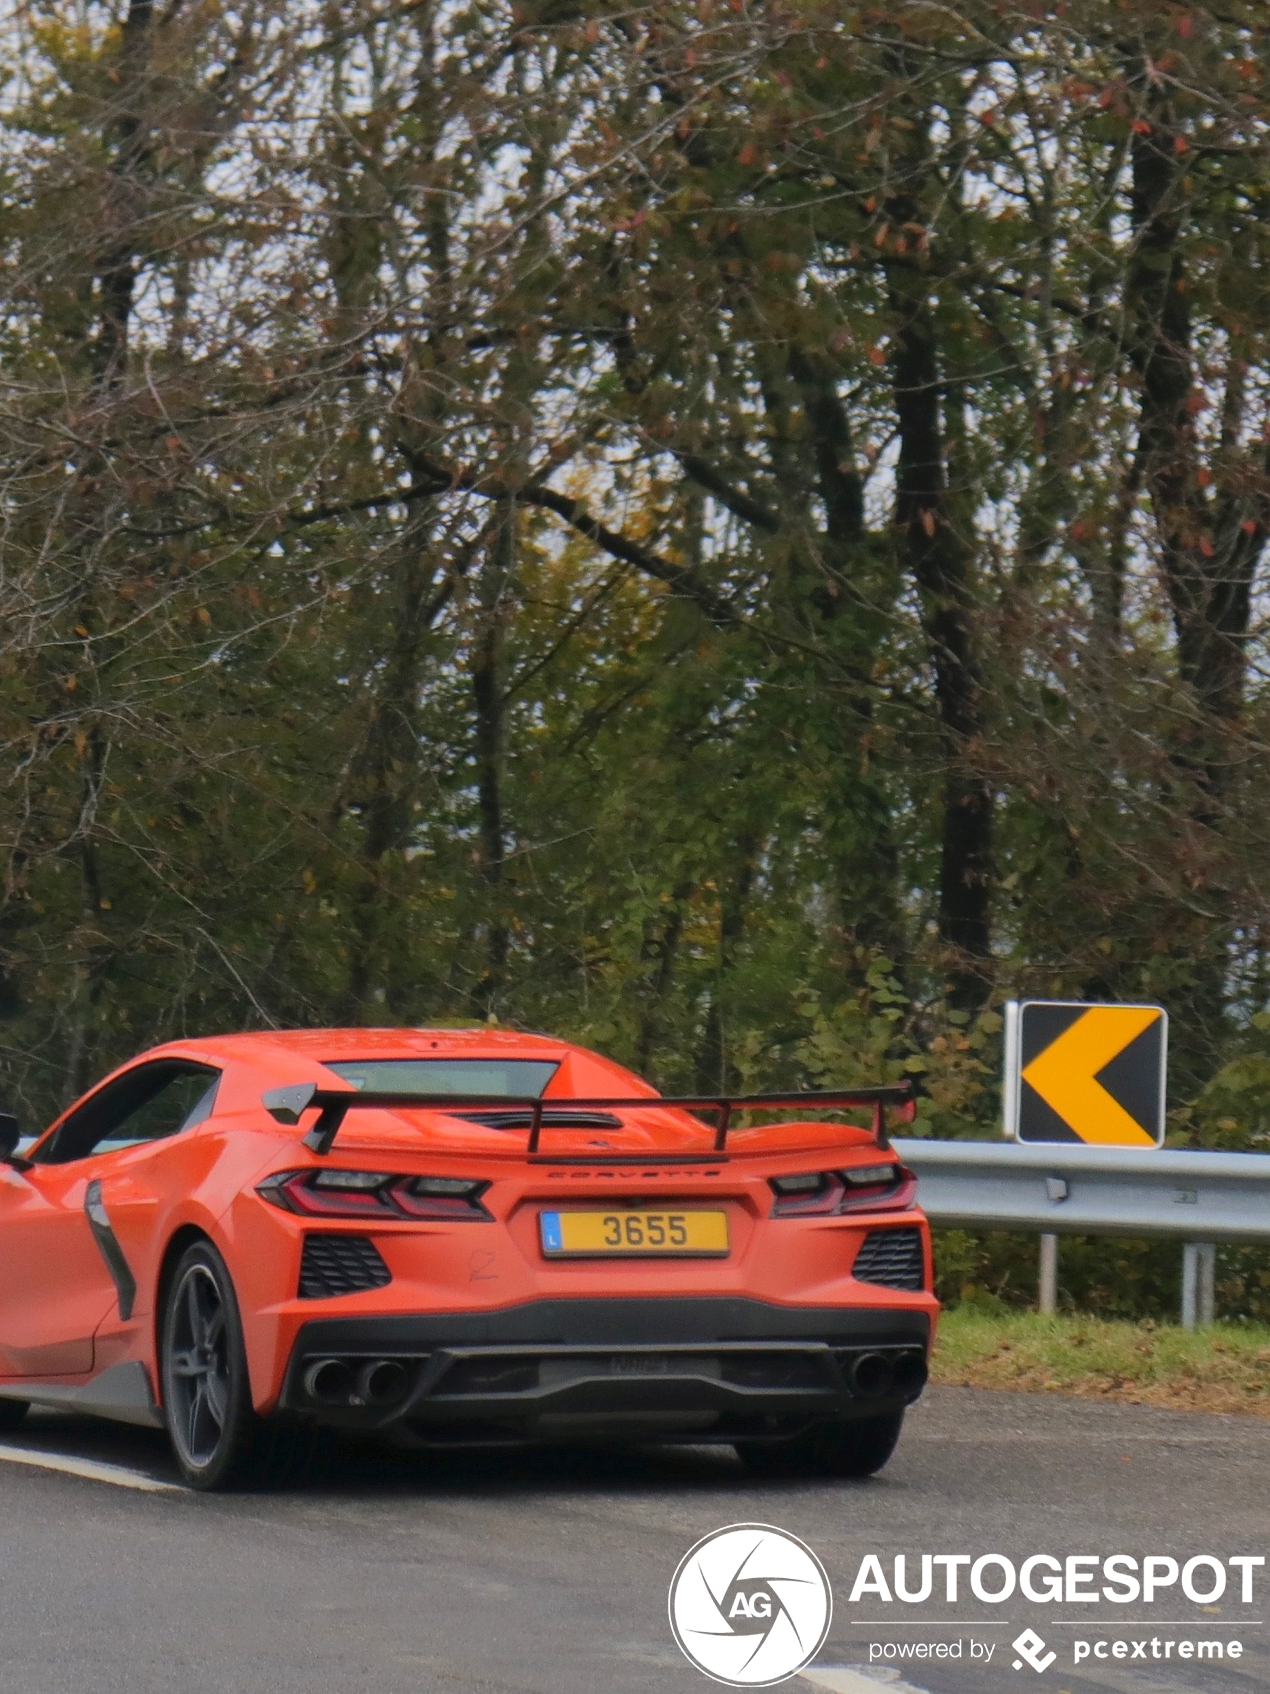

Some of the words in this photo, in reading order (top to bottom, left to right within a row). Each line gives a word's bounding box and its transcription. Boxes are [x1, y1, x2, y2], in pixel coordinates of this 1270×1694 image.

[546, 1170, 721, 1179] CORVETTE
[548, 1235, 557, 1246] L
[603, 1216, 687, 1246] 3655
